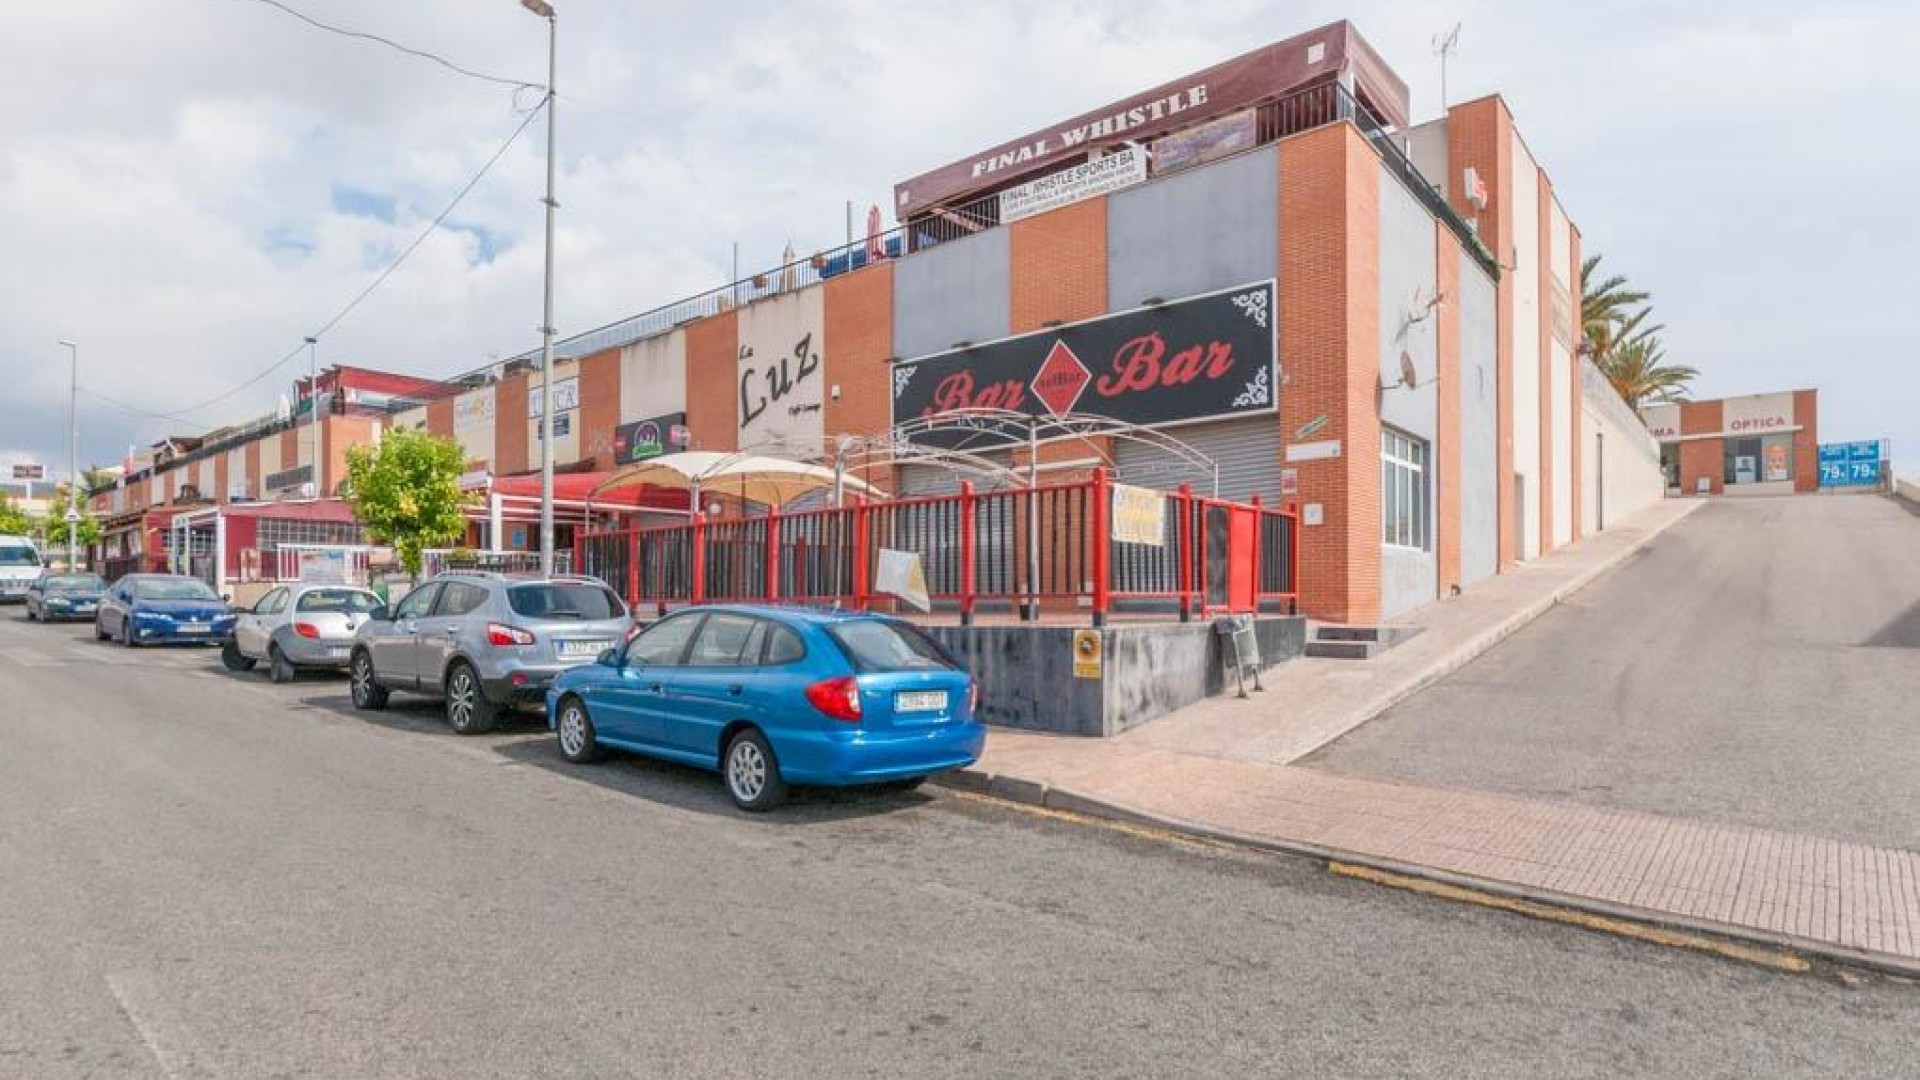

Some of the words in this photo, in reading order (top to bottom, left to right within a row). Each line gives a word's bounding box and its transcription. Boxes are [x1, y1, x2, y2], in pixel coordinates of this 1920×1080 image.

[972, 141, 1050, 178] FINAL
[1060, 84, 1208, 148] WHISTLE
[1002, 185, 1030, 204] FINAL
[1036, 170, 1075, 194] WHISTLE
[1077, 156, 1117, 181] SPORTS
[1095, 331, 1233, 397] Bar
[918, 369, 1025, 419] Bar
